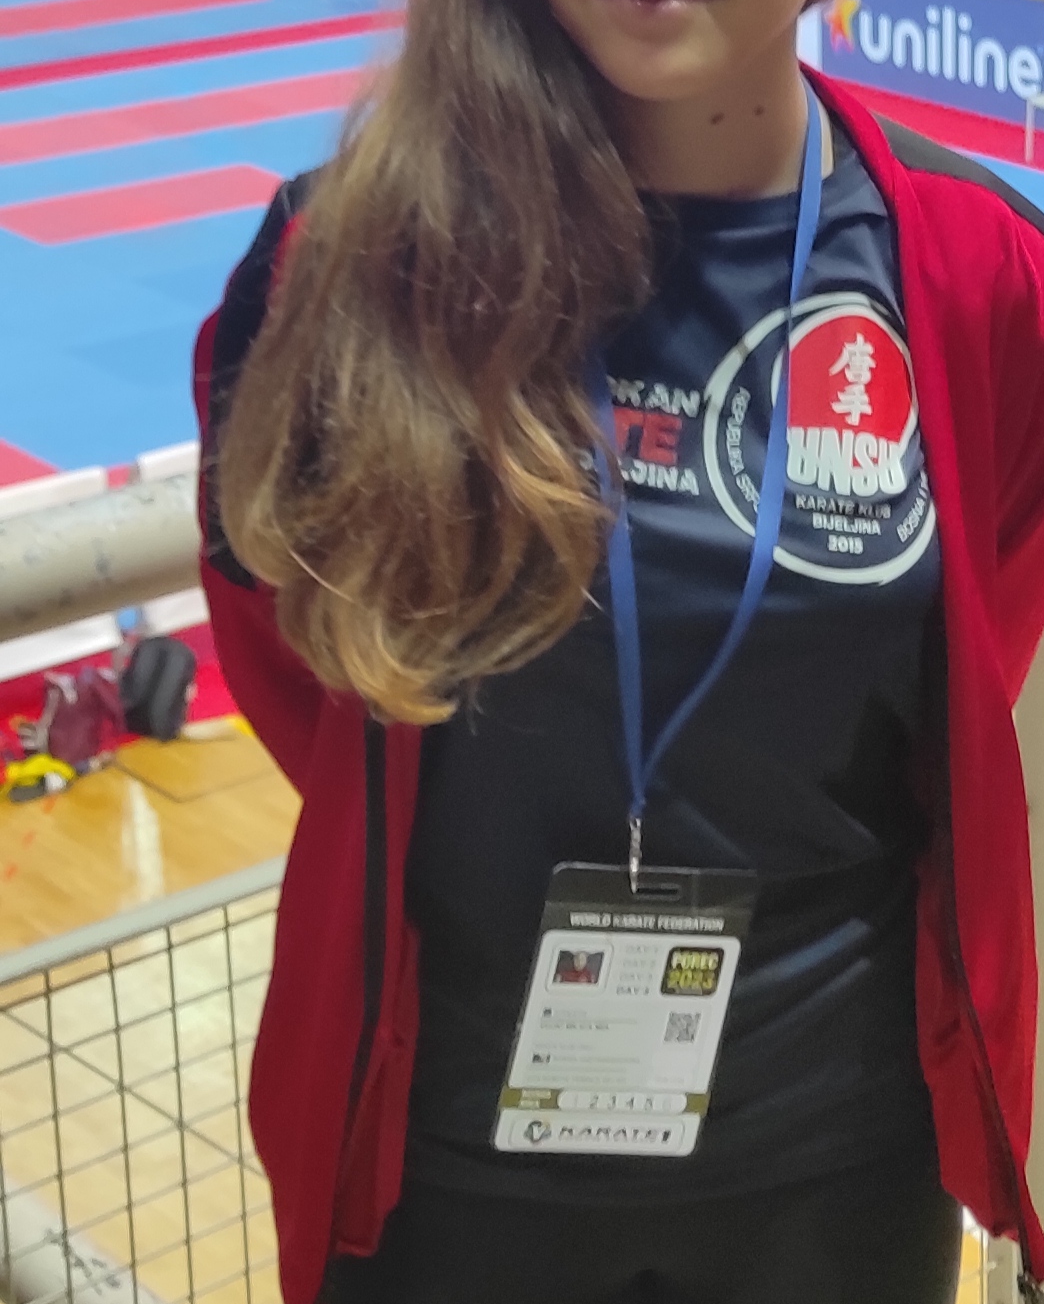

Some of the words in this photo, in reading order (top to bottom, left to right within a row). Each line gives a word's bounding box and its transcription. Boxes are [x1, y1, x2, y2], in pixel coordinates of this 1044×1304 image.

[858, 4, 1044, 101] uniline
[606, 375, 701, 418] KAN
[786, 425, 907, 497] UNSU
[795, 493, 855, 515] KARATE
[857, 502, 892, 519] KLUB
[812, 511, 882, 536] BIJELJINA
